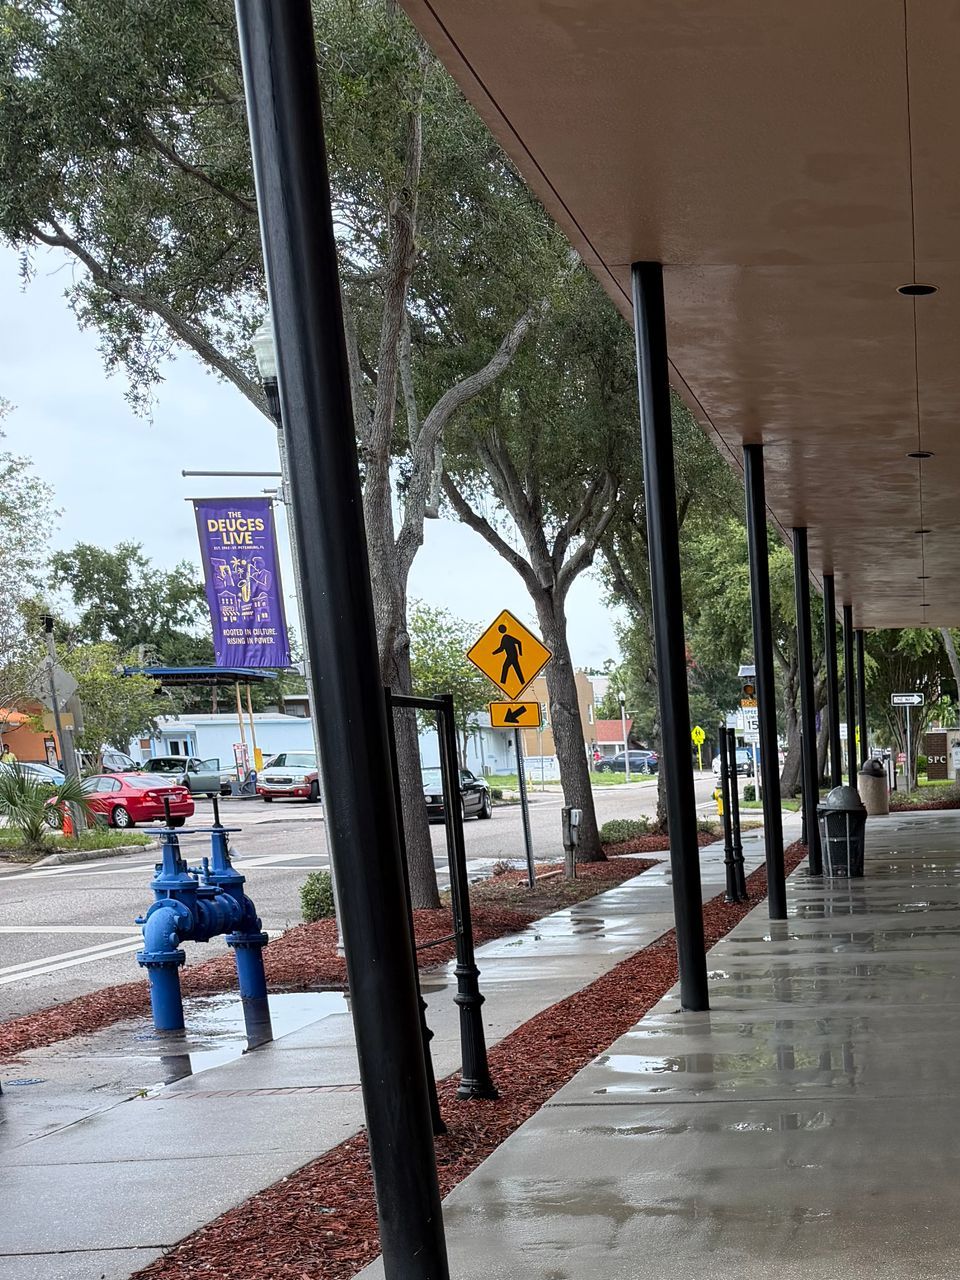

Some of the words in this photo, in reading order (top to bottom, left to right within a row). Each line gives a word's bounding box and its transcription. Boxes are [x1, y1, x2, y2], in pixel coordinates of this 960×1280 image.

[207, 518, 265, 532] DEUCES
[222, 531, 253, 545] LIVE
[747, 720, 759, 730] 15
[928, 755, 946, 763] SPC
